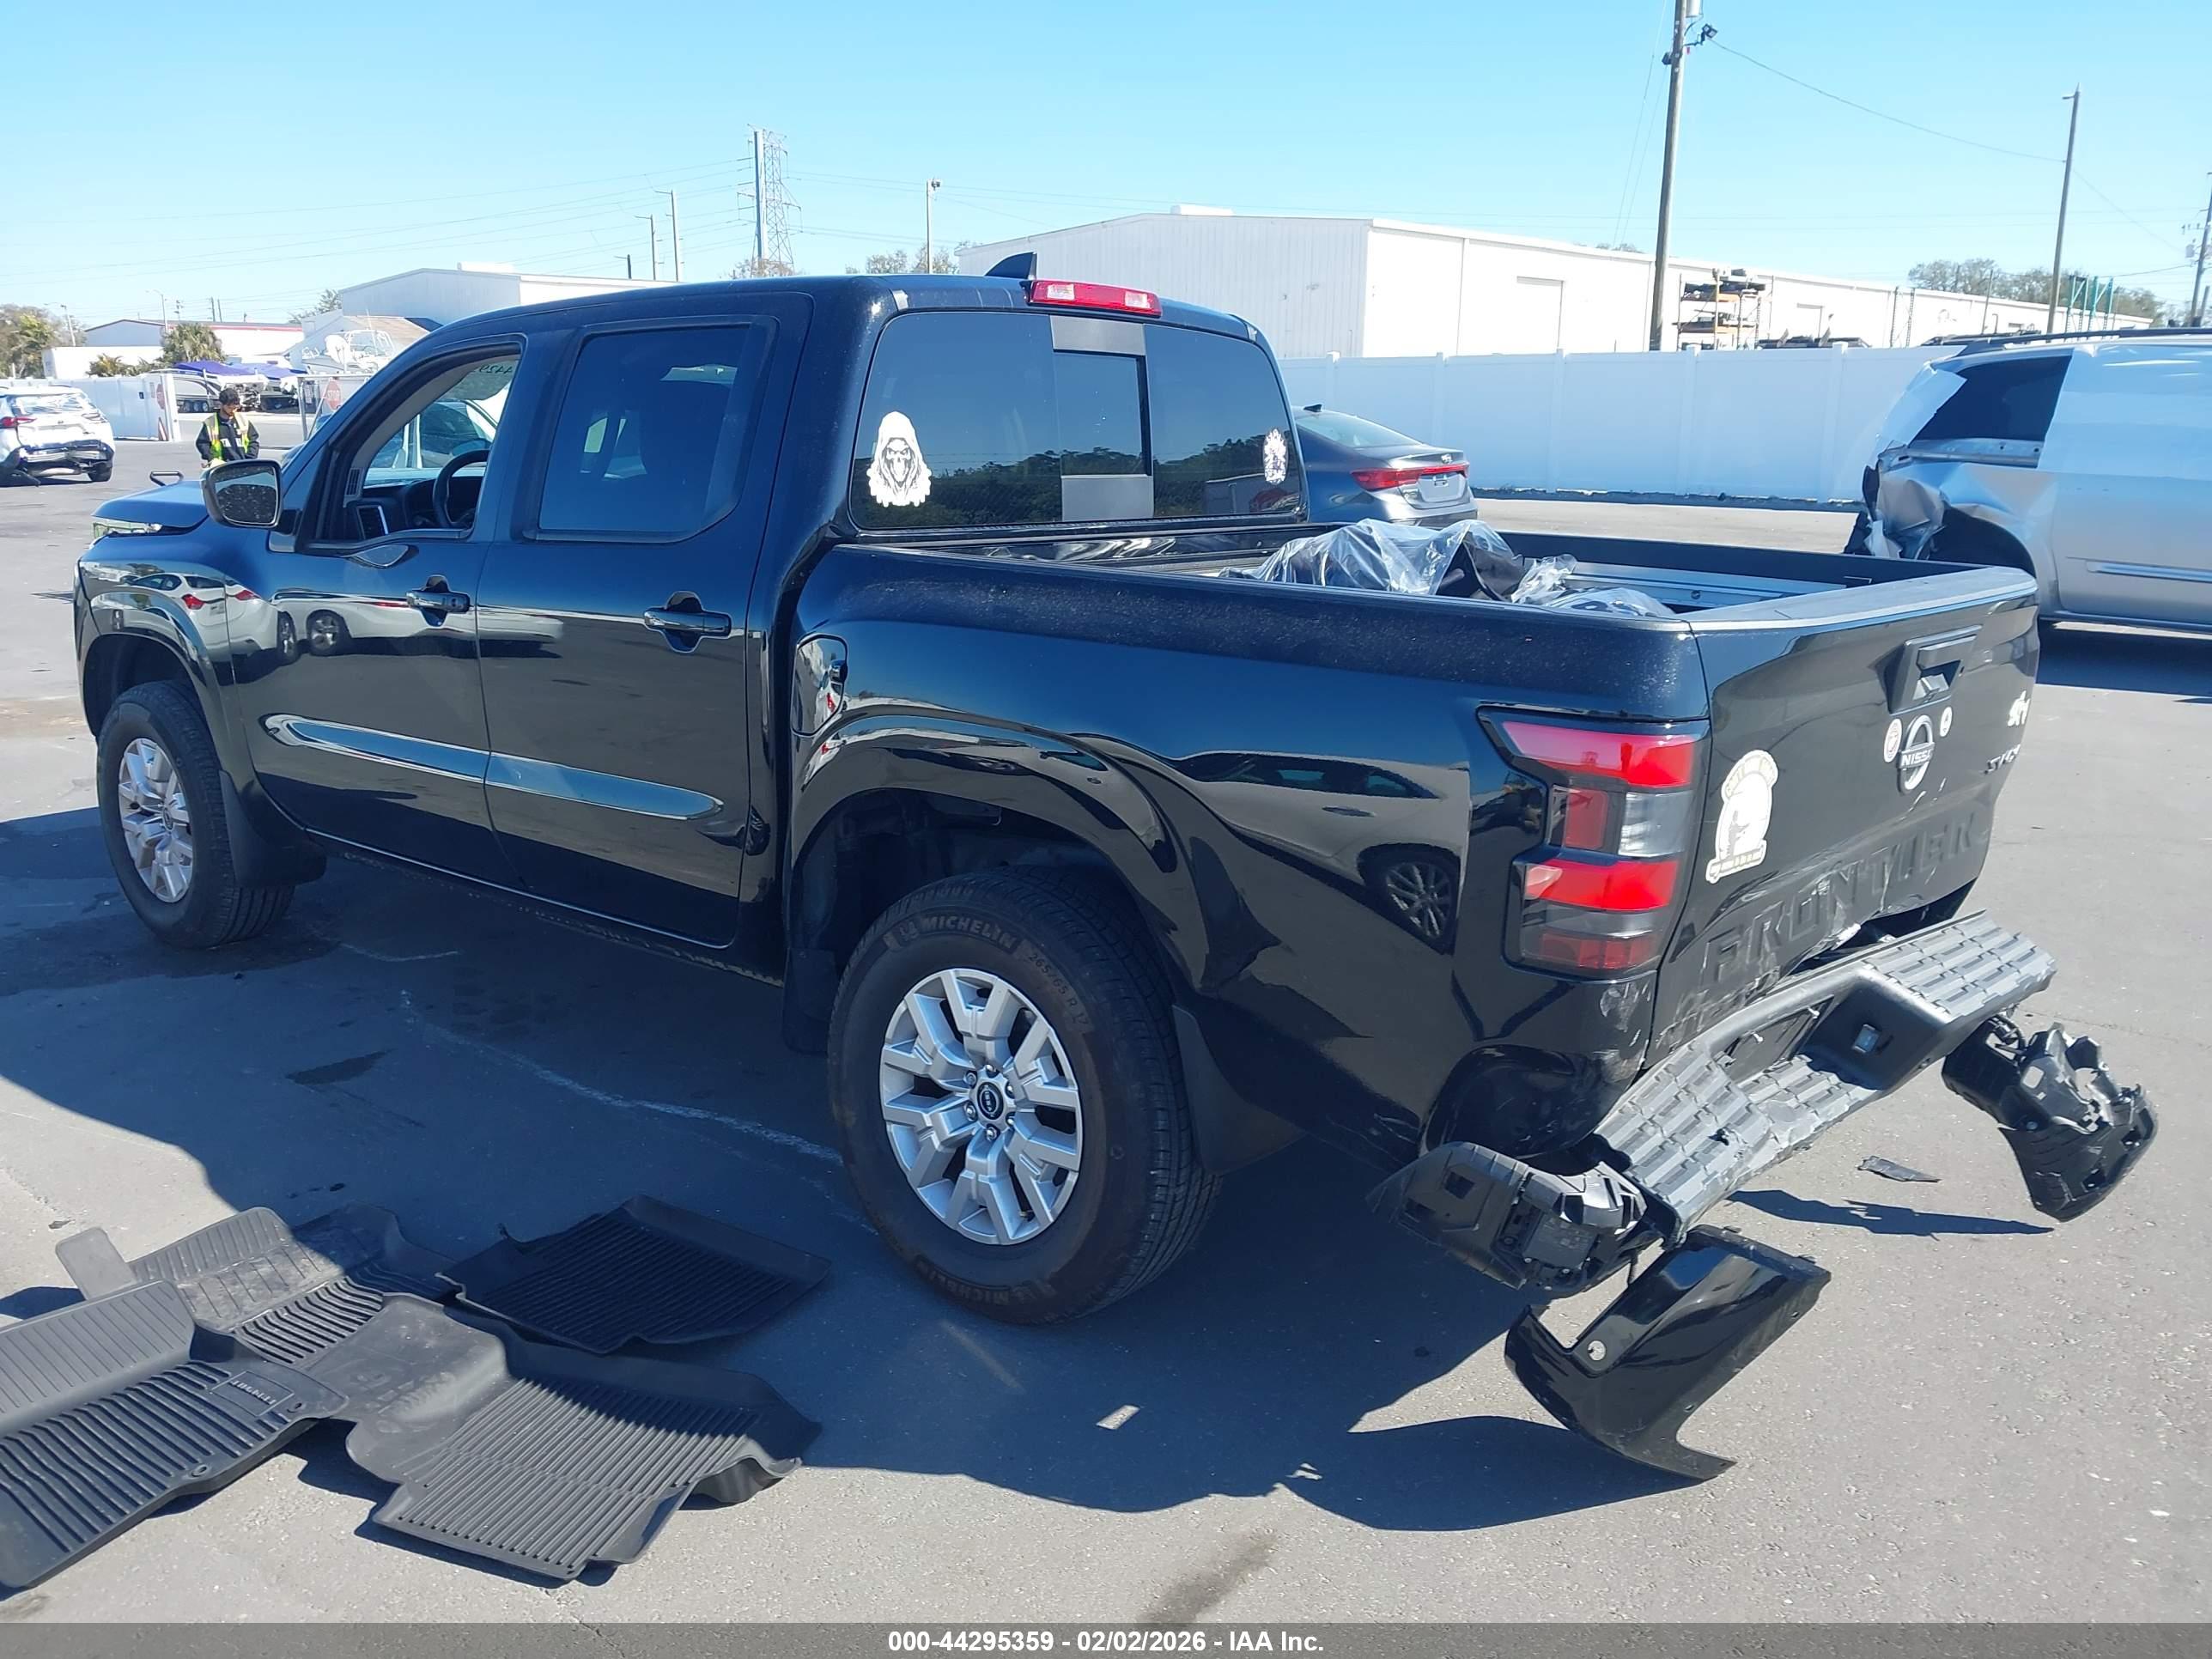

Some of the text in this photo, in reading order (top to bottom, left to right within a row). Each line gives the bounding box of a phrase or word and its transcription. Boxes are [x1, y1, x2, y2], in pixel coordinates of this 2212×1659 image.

[1900, 748, 1932, 767] NISS
[921, 915, 1018, 949] MICHELIN
[1029, 953, 1068, 994] 265/65
